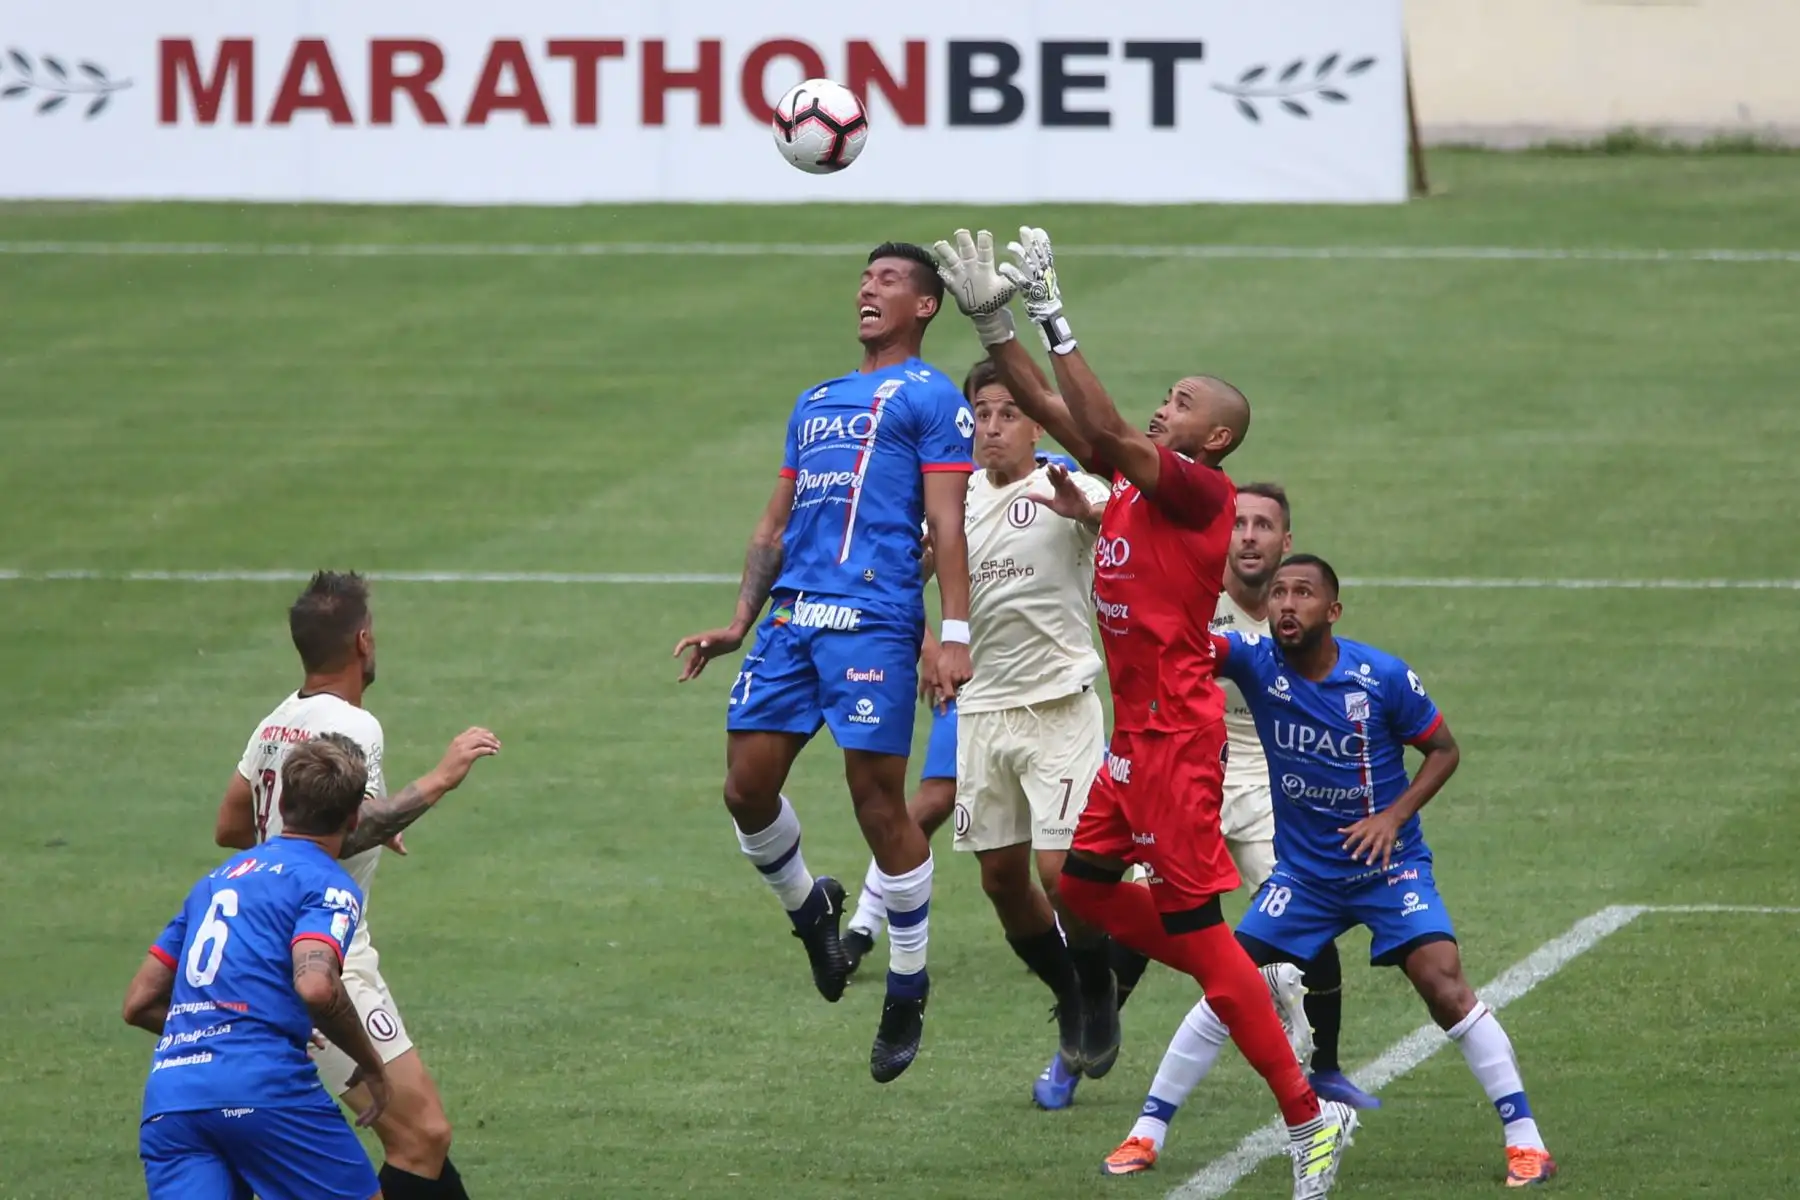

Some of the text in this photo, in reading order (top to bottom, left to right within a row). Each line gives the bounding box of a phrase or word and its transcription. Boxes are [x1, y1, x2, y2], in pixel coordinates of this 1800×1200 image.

[157, 37, 1204, 127] MARATHONBET
[796, 468, 863, 496] Danper
[969, 566, 1034, 583] UANCAYO
[980, 558, 1015, 571] CAJA
[848, 714, 880, 724] WALON
[1058, 778, 1073, 820] 7
[1281, 773, 1374, 806] Danper
[1041, 827, 1074, 836] marath
[1258, 881, 1292, 918] 18
[186, 889, 239, 989] 6
